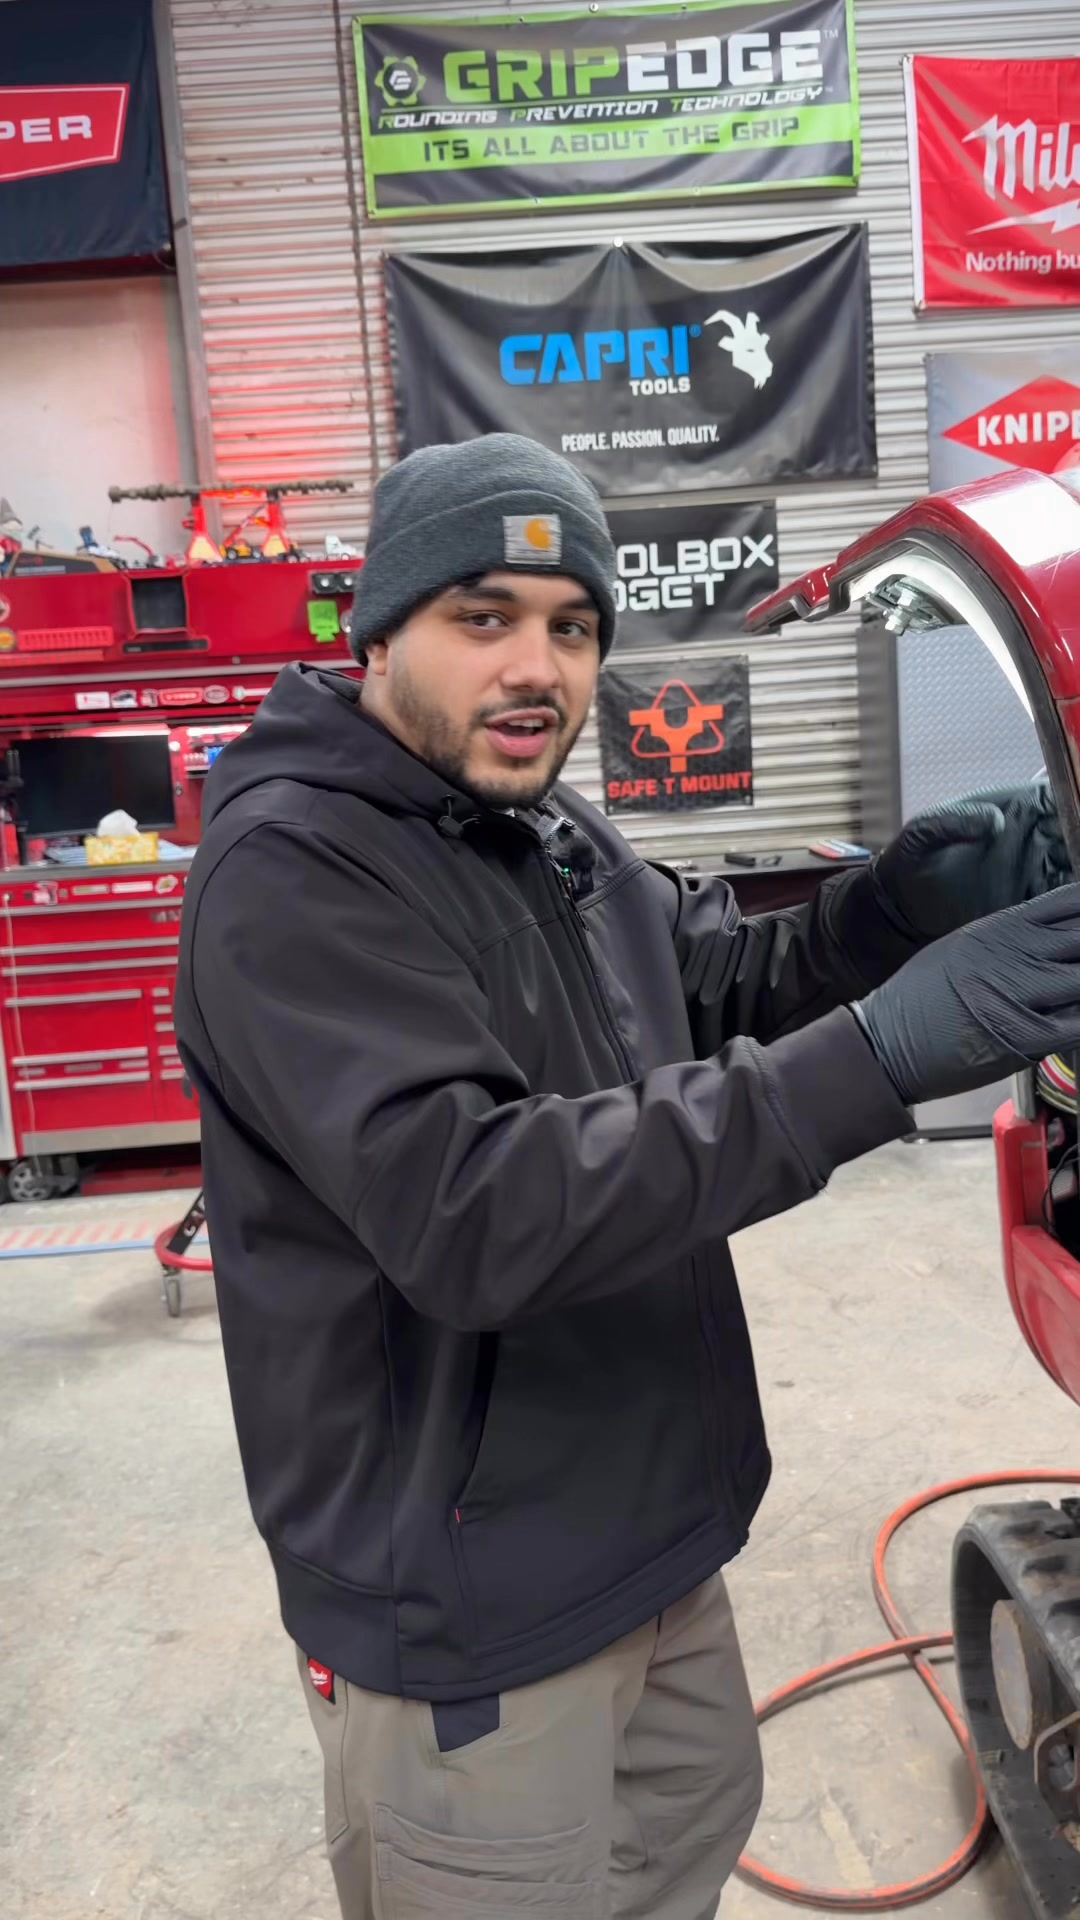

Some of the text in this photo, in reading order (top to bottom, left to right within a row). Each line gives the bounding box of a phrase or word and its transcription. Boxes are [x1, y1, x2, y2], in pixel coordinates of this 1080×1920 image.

[443, 30, 823, 103] GRIPEDGE
[378, 87, 823, 129] ROUNDING PREVENTION TECHNOLOGY
[424, 117, 799, 161] ITS ALL ABOUT THE GRIP
[961, 114, 1080, 199] Mil
[966, 252, 1052, 274] Nothing
[501, 325, 690, 385] CAPRI
[629, 377, 691, 396] TOOLS
[561, 424, 720, 452] PEOPLE. PASSION. QUALITY.
[608, 770, 752, 799] SAFE T MOUNT
